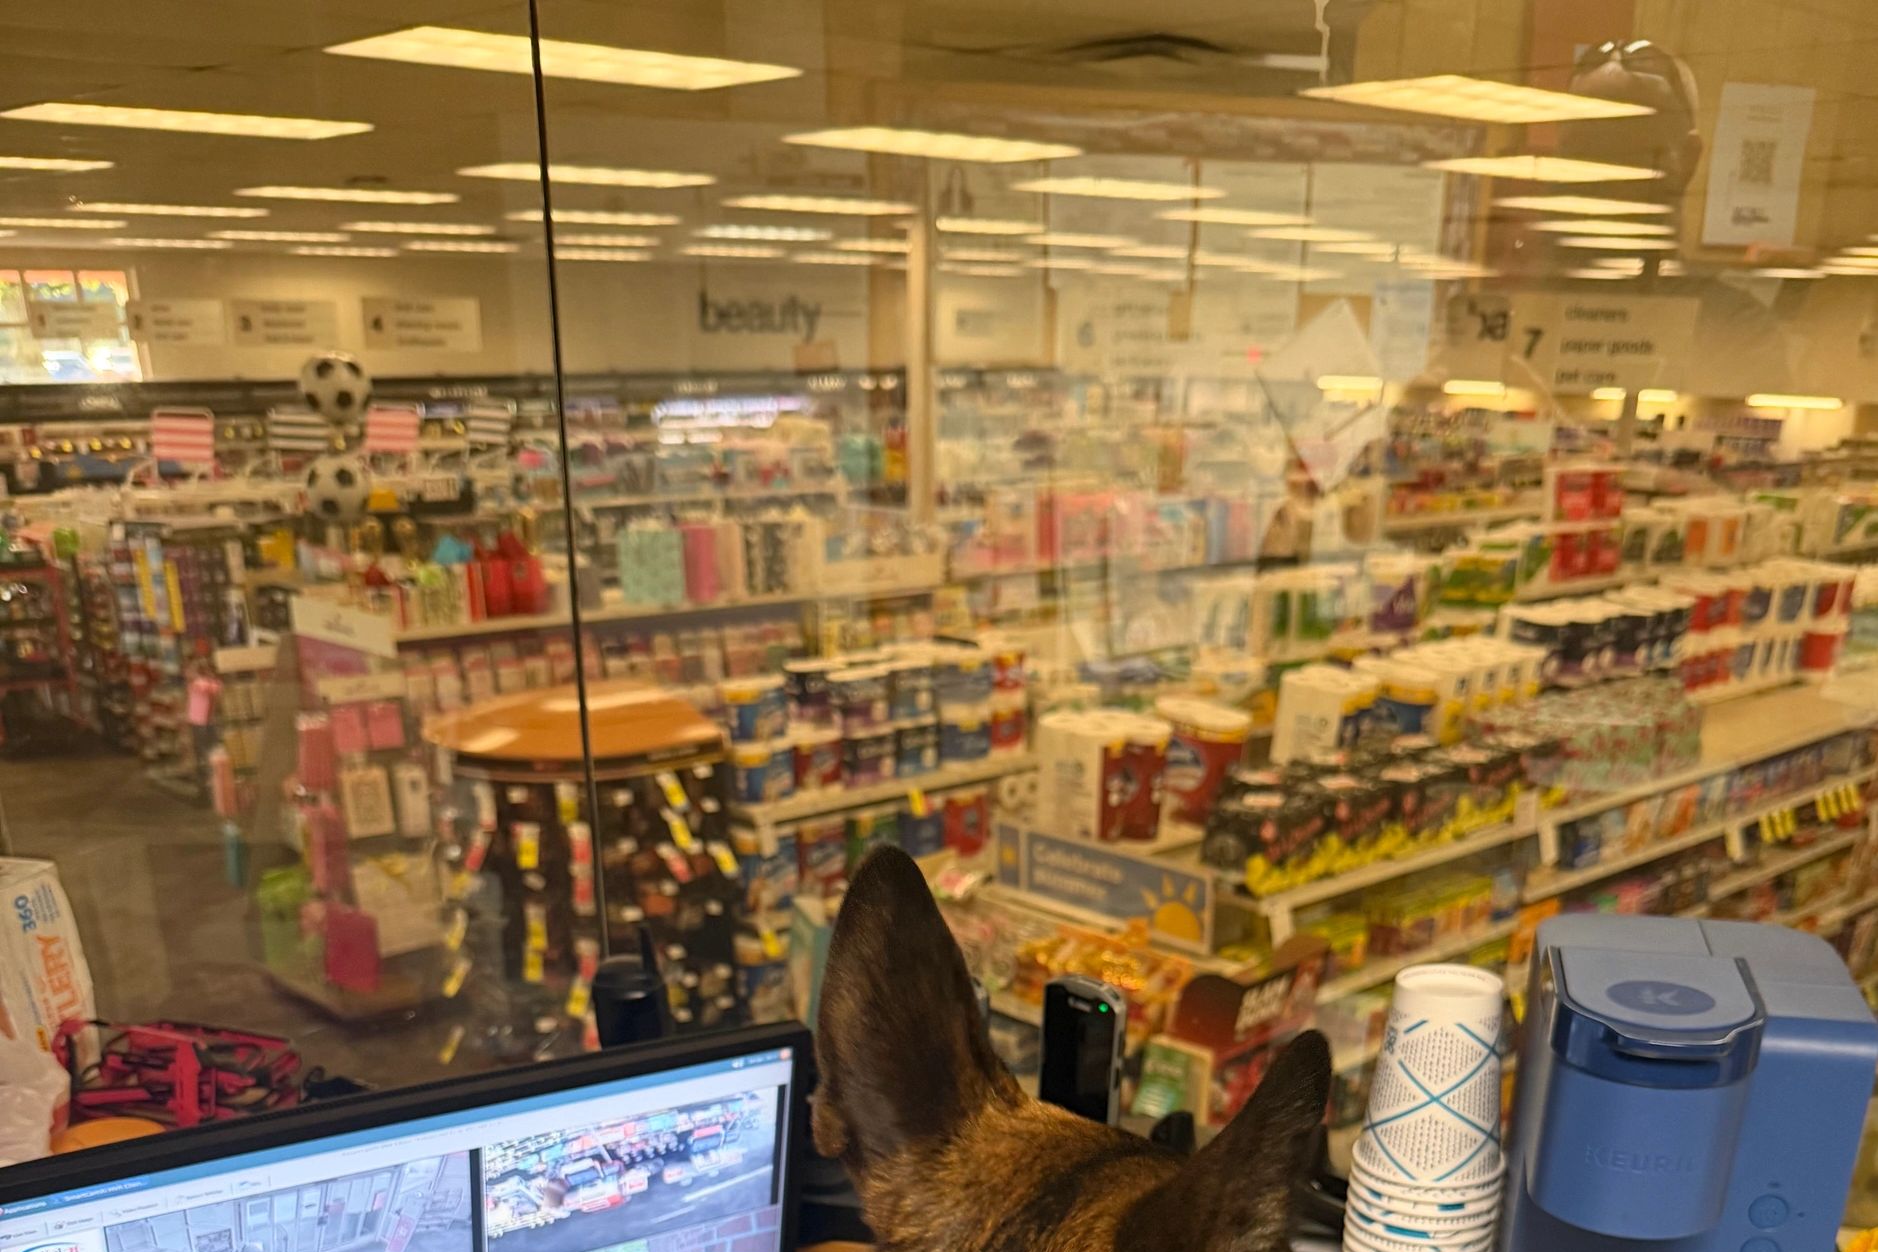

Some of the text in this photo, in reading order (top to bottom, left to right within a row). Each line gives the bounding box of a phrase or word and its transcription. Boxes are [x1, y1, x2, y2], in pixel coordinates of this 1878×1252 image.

[698, 290, 822, 344] beauty
[1565, 304, 1628, 322] cleaners
[1524, 327, 1544, 358] 7
[1560, 338, 1654, 356] paper goods
[1554, 368, 1579, 385] pet
[14, 895, 37, 934] 360
[1584, 1142, 1697, 1175] KEURI
